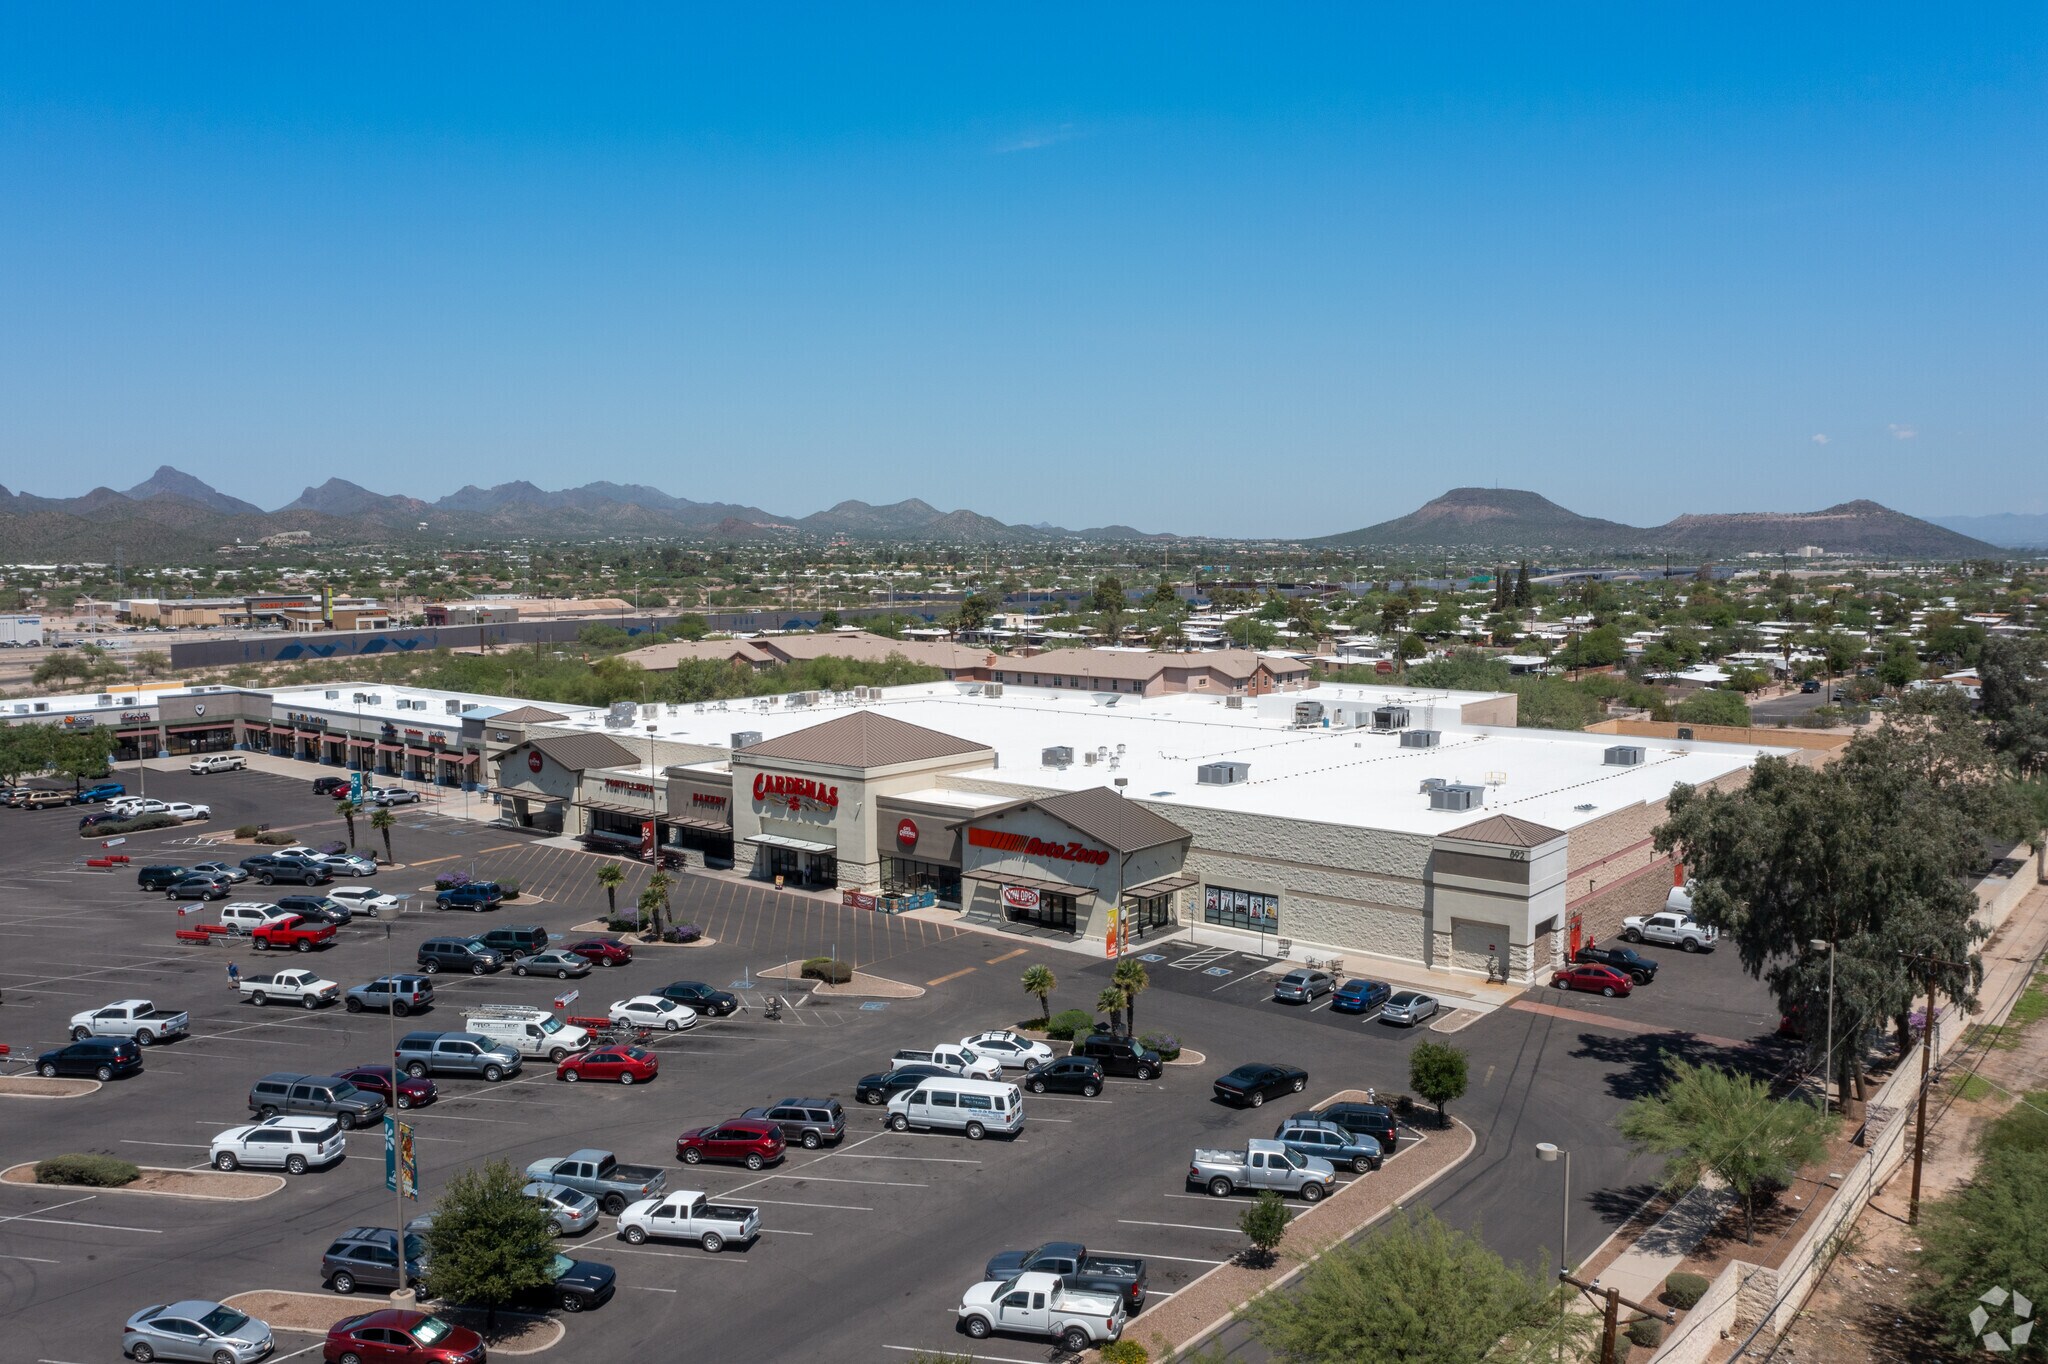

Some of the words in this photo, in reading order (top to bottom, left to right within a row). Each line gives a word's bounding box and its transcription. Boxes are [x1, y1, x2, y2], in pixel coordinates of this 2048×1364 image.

[752, 772, 839, 807] CARDENAS
[692, 792, 727, 806] BAKERY
[1024, 836, 1110, 866] AutoZone
[1509, 849, 1525, 861] 892
[1020, 889, 1038, 903] OPEN
